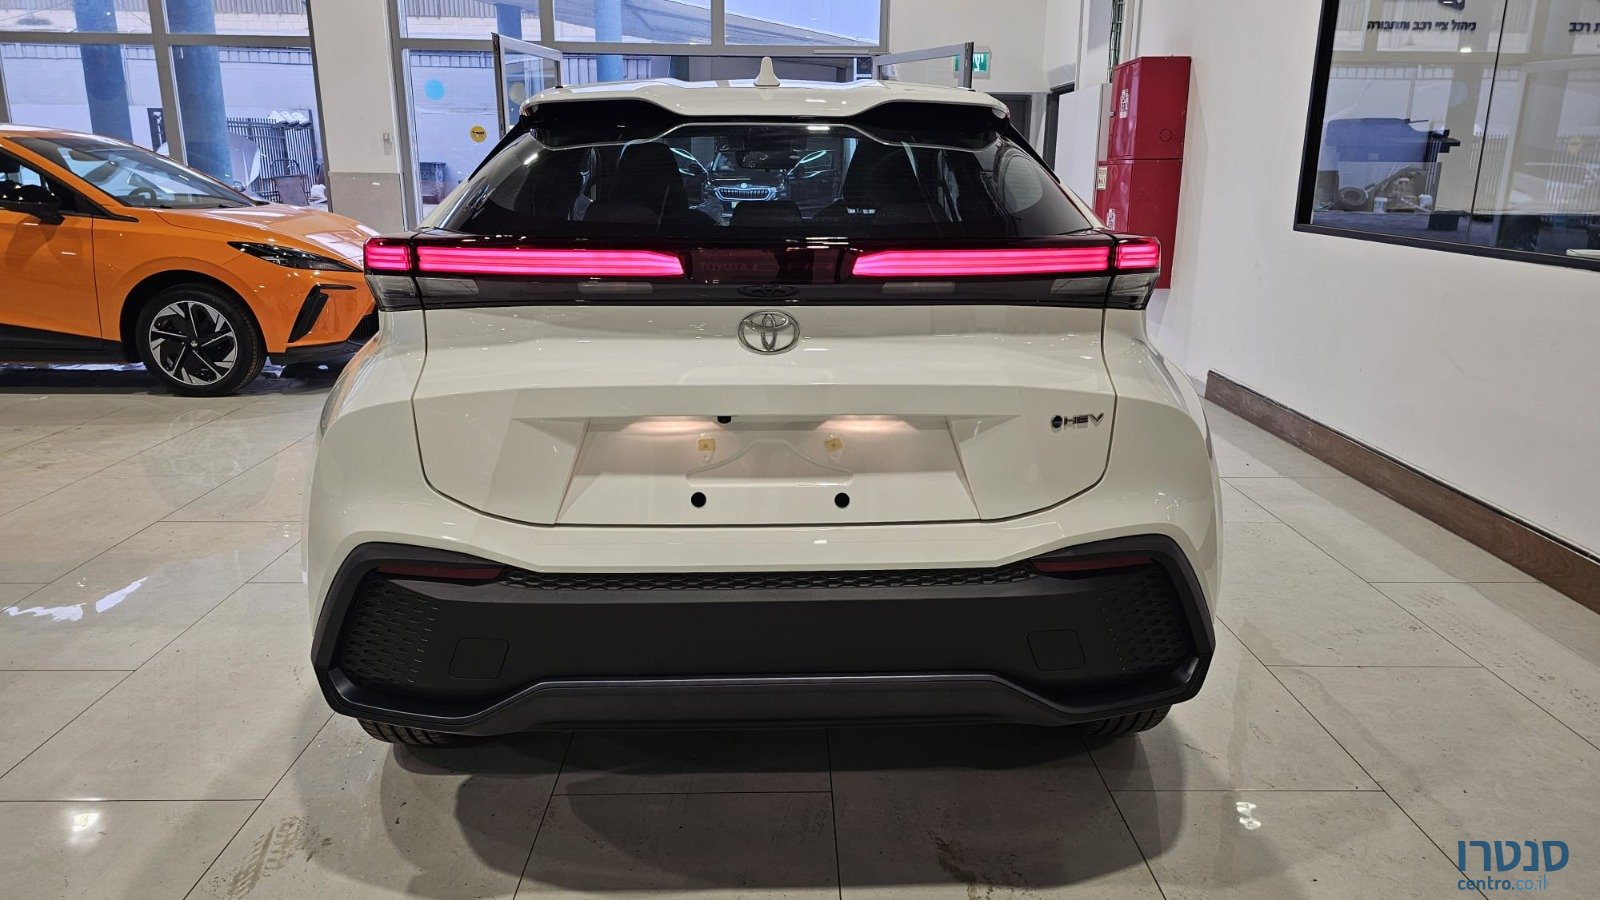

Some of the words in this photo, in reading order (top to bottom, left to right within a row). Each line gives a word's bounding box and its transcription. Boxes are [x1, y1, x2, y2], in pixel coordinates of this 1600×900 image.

[1412, 21, 1432, 31] רכב
[1451, 19, 1477, 31] ניהול
[1568, 22, 1591, 32] רכב
[699, 262, 748, 272] TOYOTA
[1063, 413, 1104, 426] HEV
